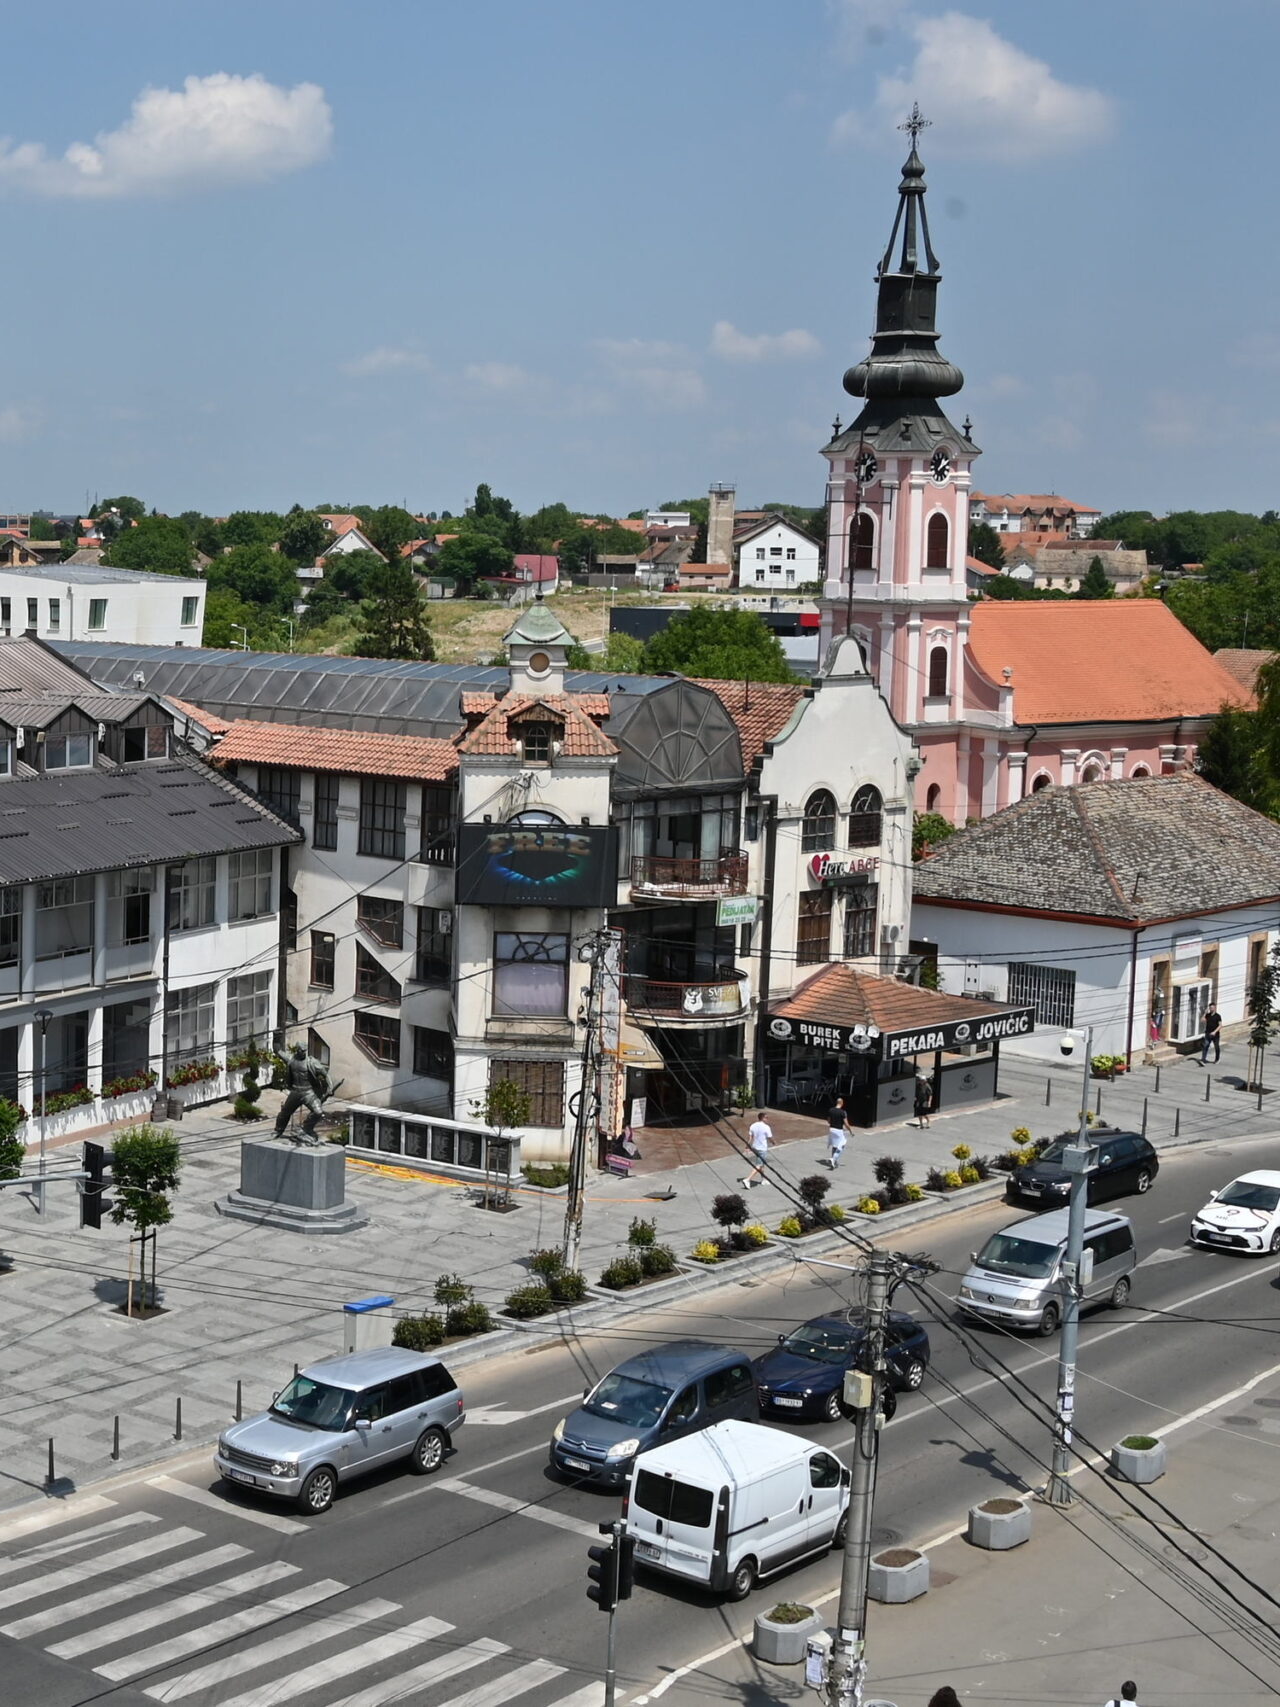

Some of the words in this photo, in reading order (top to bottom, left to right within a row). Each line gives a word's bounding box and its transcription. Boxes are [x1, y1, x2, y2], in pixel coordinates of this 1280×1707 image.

[800, 1023, 841, 1040] BUREK
[890, 1031, 945, 1056] PEKARA
[976, 1011, 1029, 1040] JOVIČIĆ
[804, 1035, 808, 1045] I
[813, 1037, 840, 1050] PITE
